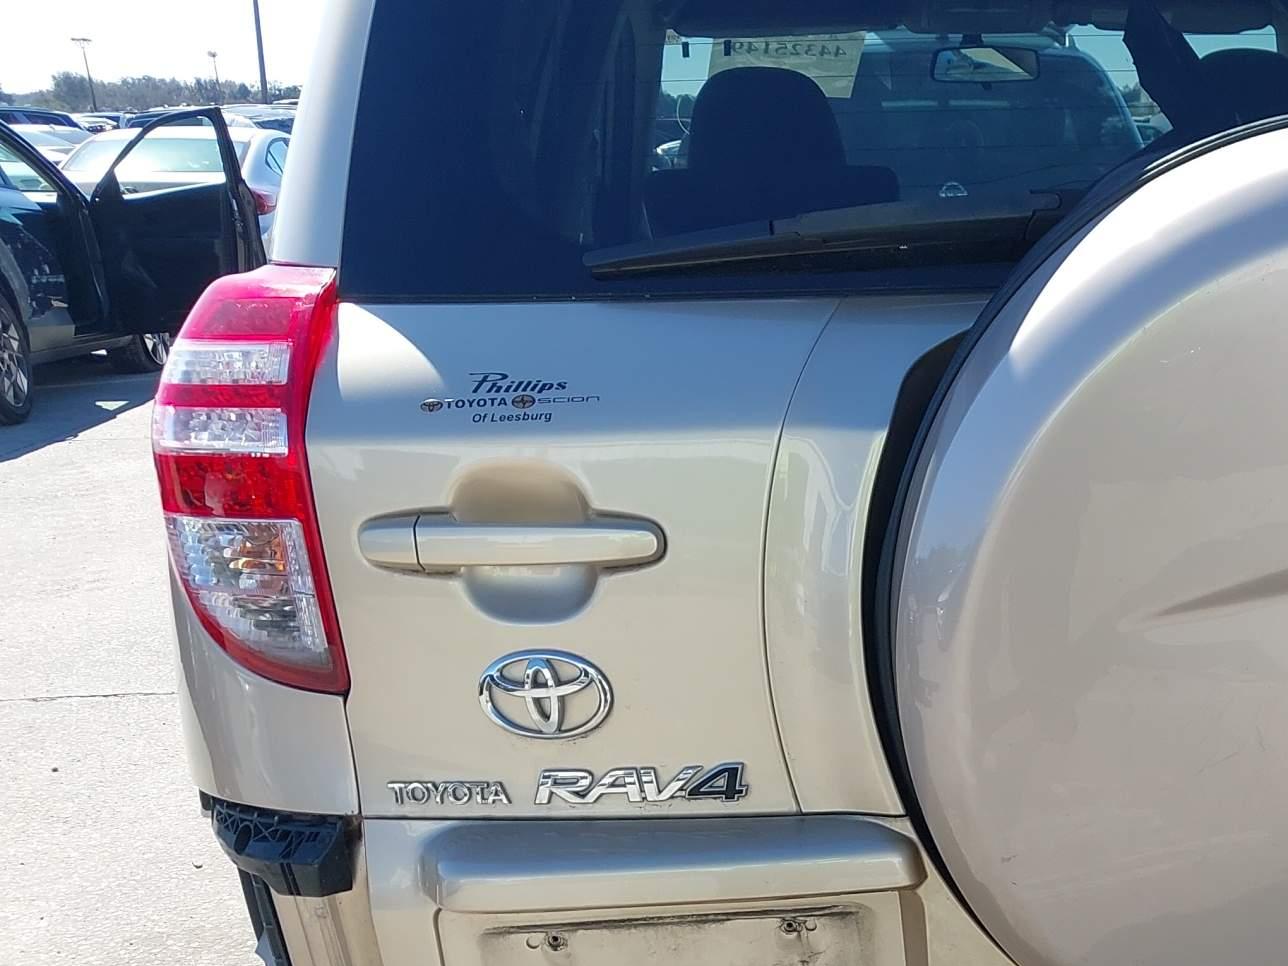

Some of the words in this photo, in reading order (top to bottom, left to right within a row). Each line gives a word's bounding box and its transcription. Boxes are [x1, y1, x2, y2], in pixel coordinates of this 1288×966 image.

[468, 372, 568, 395] Phillips
[446, 397, 508, 410] TOYOTA
[472, 412, 488, 424] Of
[491, 412, 553, 423] Leesburg
[387, 781, 513, 805] TOYOTA
[534, 762, 749, 805] RAV4
